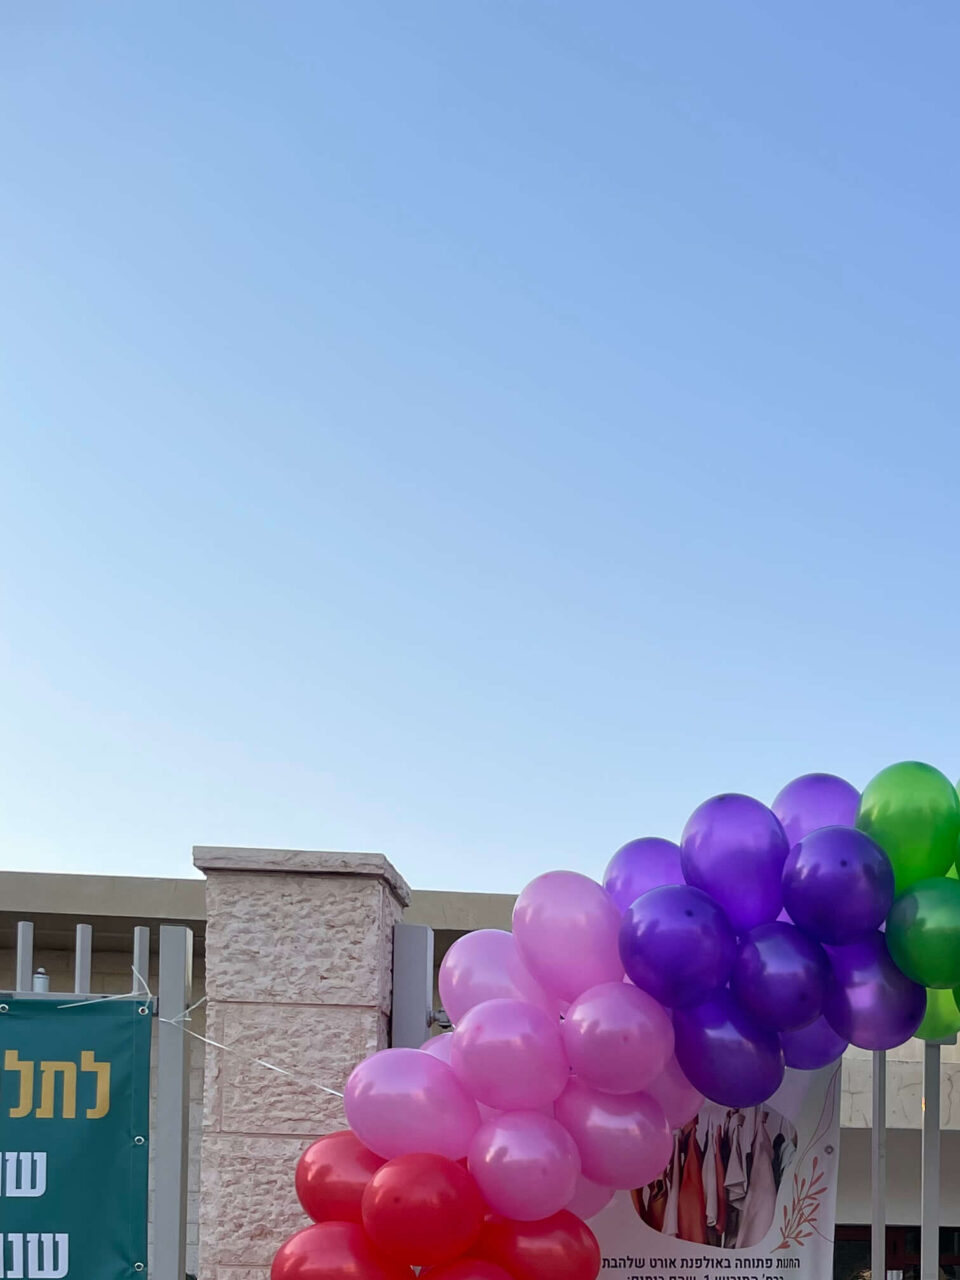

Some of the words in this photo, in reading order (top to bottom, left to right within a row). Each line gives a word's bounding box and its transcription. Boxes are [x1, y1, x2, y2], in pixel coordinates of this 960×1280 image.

[0, 1152, 47, 1197] ש
[602, 1256, 645, 1269] שלהבת
[649, 1258, 677, 1269] אורט
[680, 1256, 731, 1269] באולפנת
[735, 1258, 773, 1269] פתוחה
[776, 1258, 800, 1269] החנות
